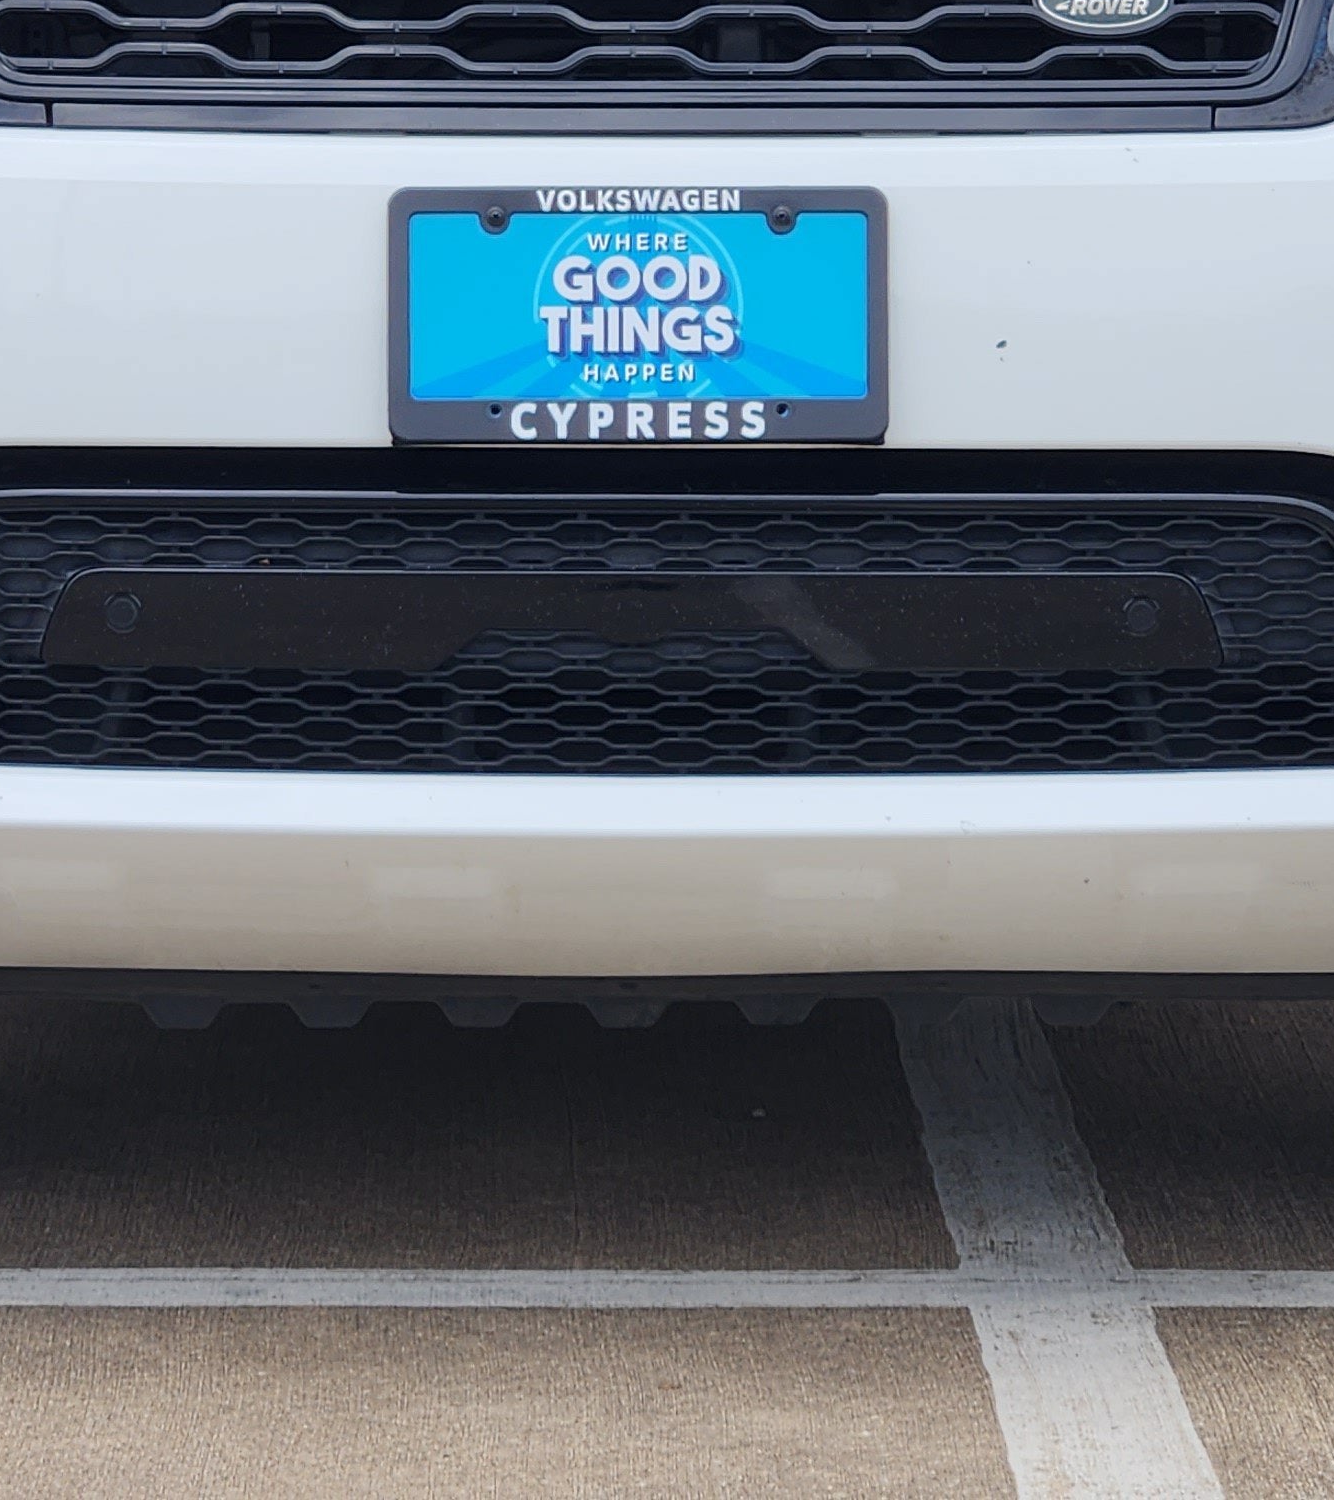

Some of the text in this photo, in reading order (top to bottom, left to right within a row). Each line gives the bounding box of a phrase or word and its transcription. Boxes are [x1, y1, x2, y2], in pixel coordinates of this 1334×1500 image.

[535, 188, 742, 212] VOLKSWAGEN
[586, 232, 689, 252] WHERE
[552, 254, 725, 303] GOOD
[539, 305, 739, 355] THINGS
[583, 363, 697, 383] HAPPEN
[509, 401, 767, 440] CYPRESS
